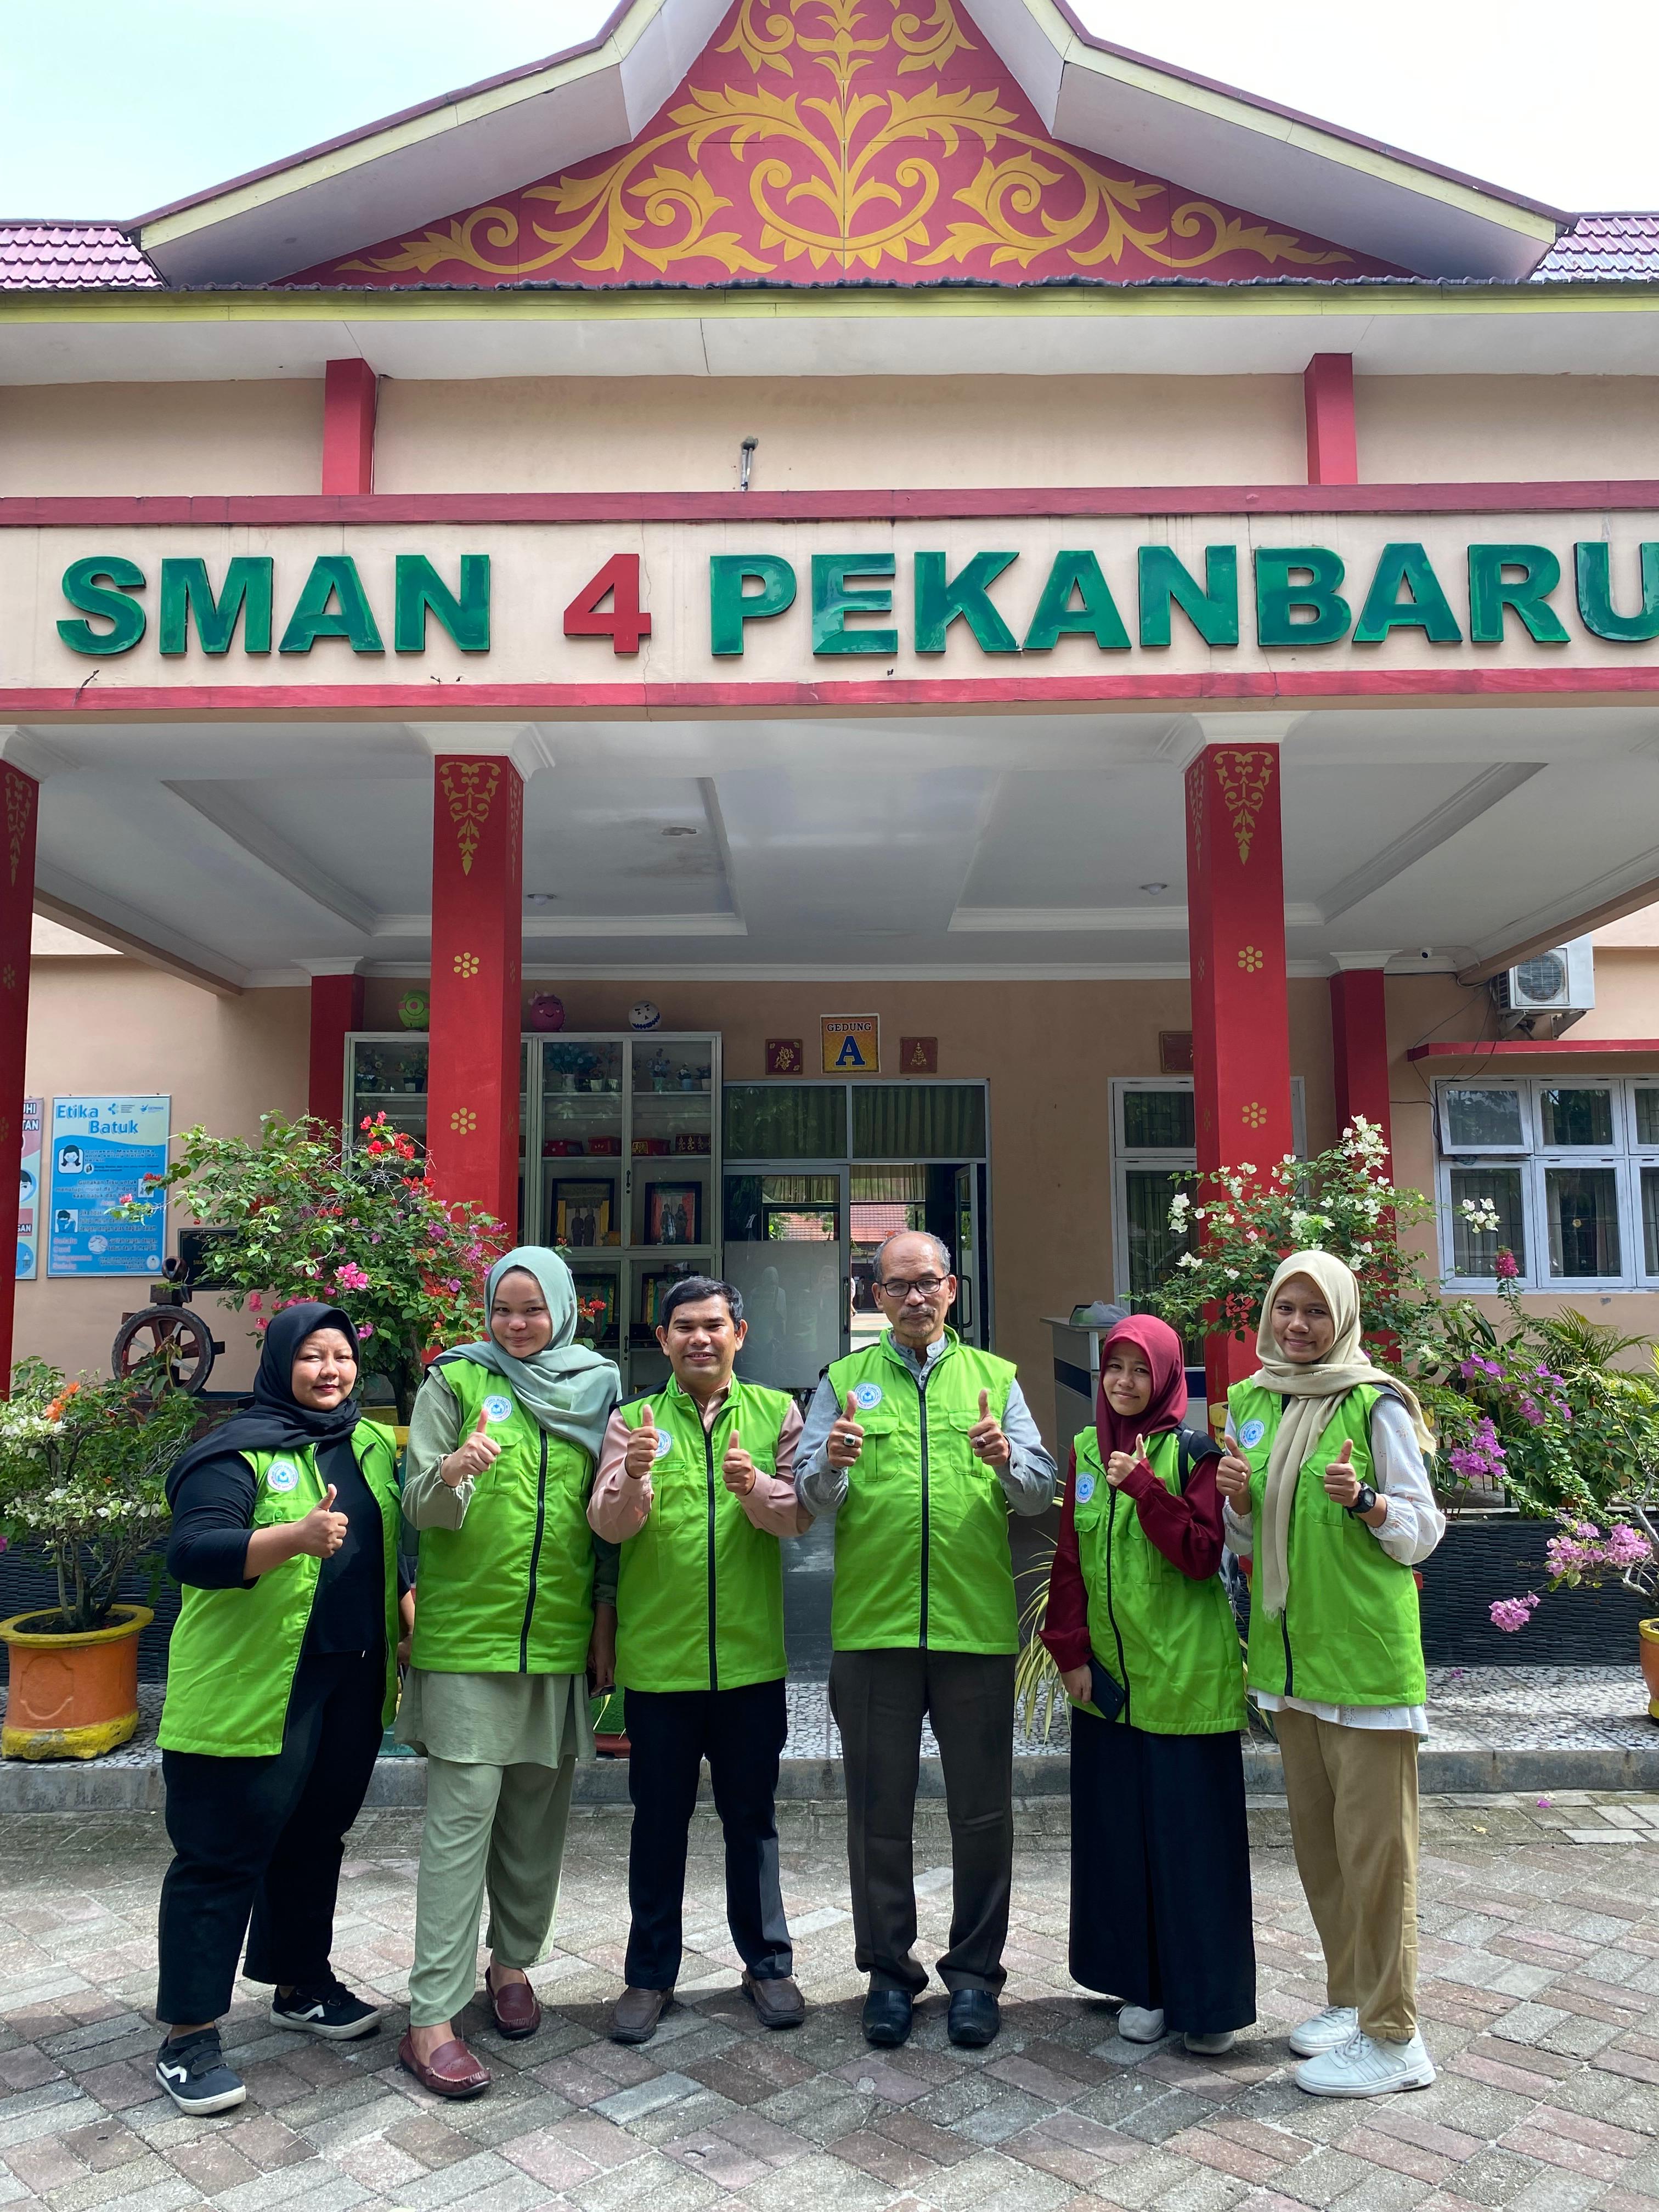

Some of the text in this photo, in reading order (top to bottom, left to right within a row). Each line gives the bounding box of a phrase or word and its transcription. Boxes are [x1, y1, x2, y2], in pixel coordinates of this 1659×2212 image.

[56, 540, 1659, 655] SMAN 4 PEKANBARU
[827, 1023, 872, 1031] GEDUNG
[835, 1035, 866, 1066] A
[57, 1104, 98, 1119] Etika
[88, 1120, 138, 1134] Batuk
